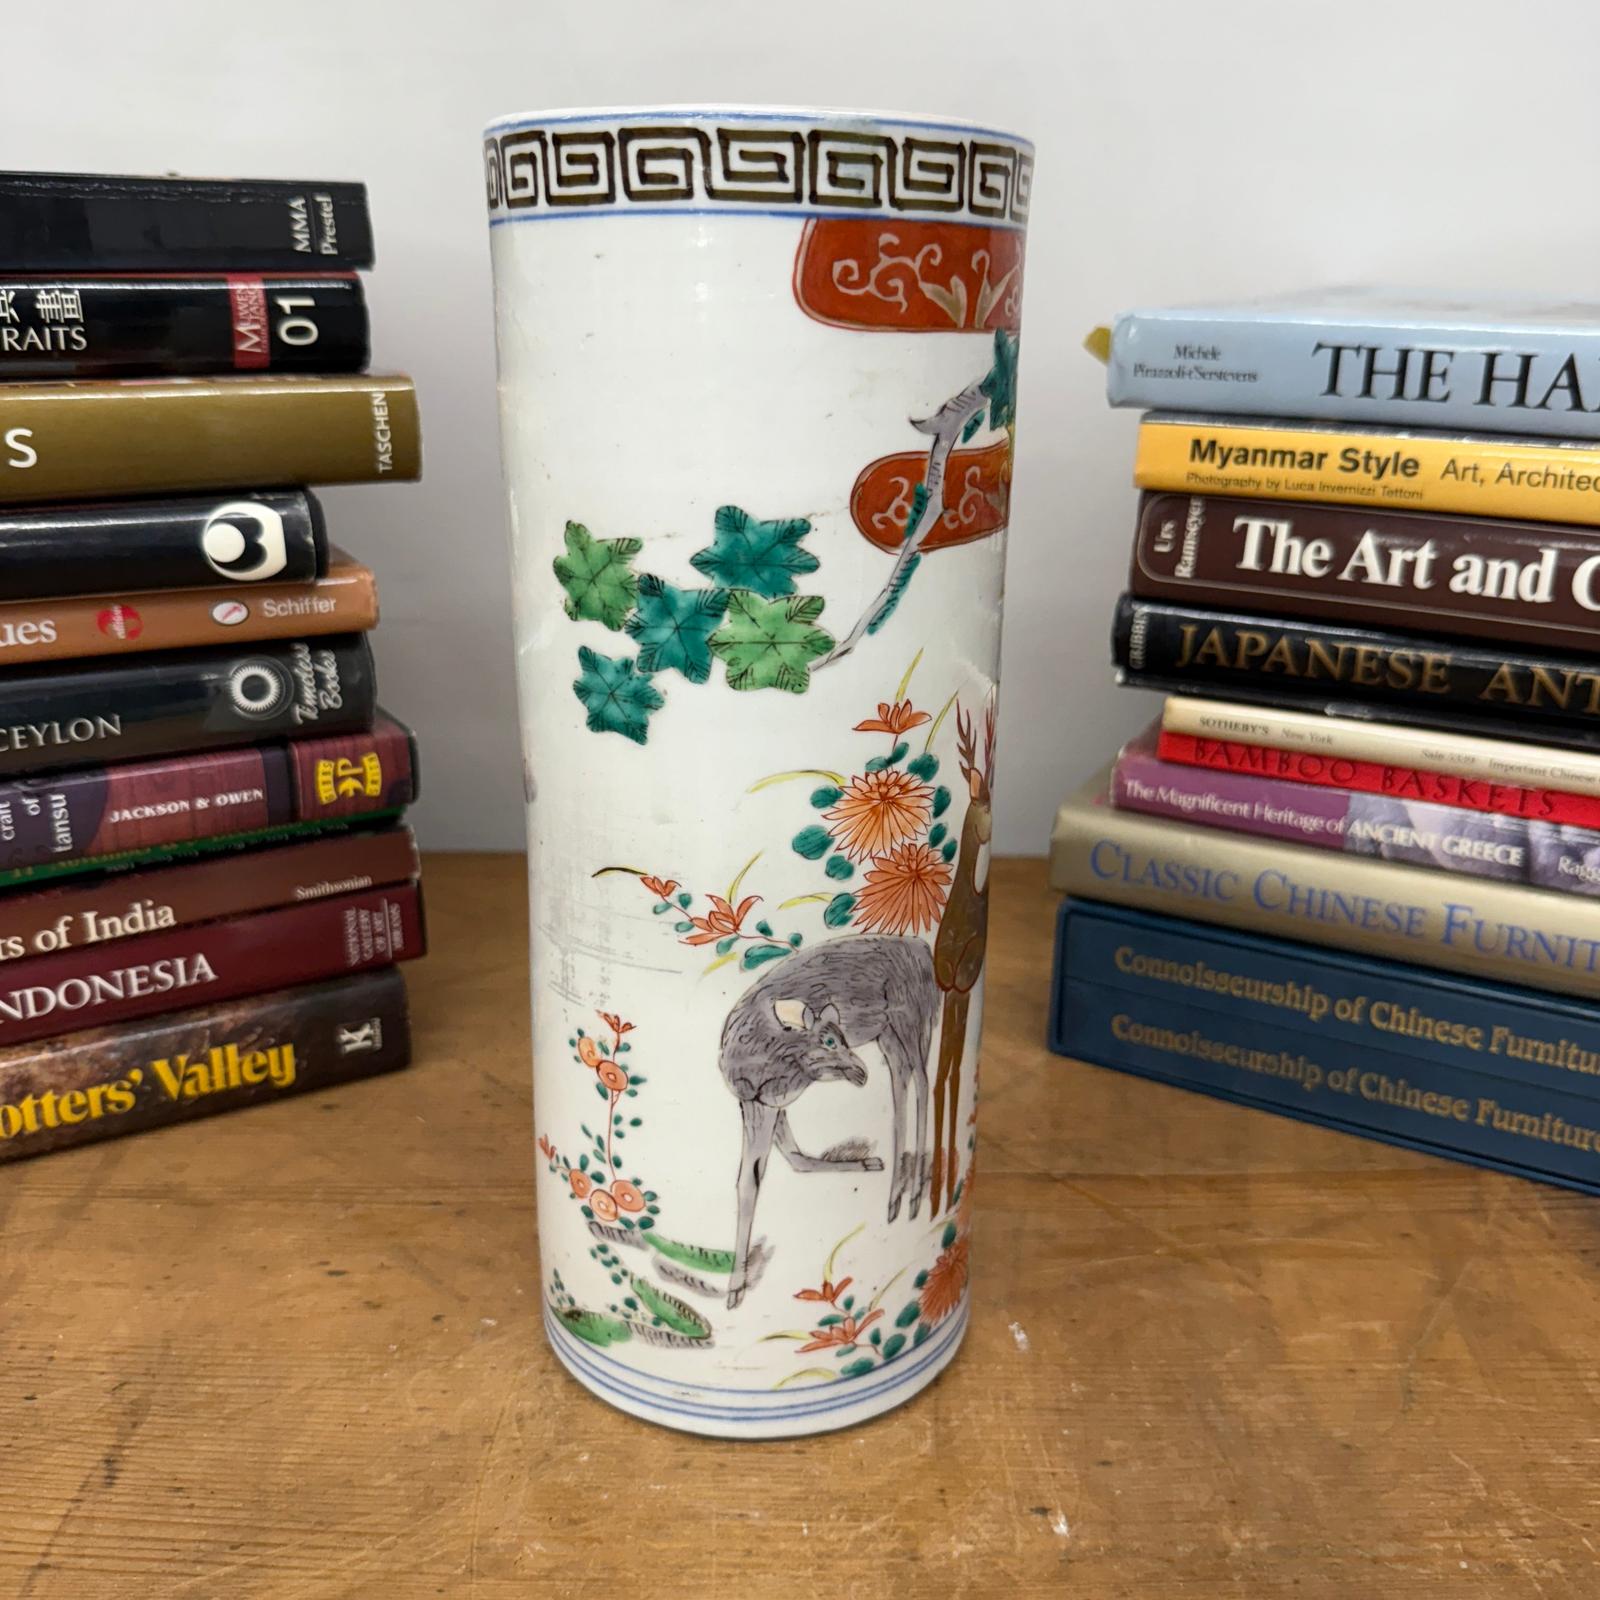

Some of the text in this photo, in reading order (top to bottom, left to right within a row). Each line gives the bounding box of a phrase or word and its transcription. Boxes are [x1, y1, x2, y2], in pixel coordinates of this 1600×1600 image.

[288, 196, 311, 253] MMA
[314, 194, 338, 255] Prestel
[2, 326, 87, 351] RAITS
[276, 296, 319, 346] 01
[1312, 340, 1600, 413] THE HA
[5, 427, 38, 469] S
[372, 392, 392, 474] TASCHEN
[1189, 438, 1328, 470] Myanmar
[1338, 446, 1421, 481] Style
[1440, 457, 1485, 488] Art,
[1186, 471, 1262, 490] Photography
[1266, 477, 1280, 492] by
[1284, 479, 1315, 492] Luca
[1153, 518, 1177, 553] Urs
[1232, 513, 1335, 580] The
[1338, 529, 1440, 591] Art
[1448, 547, 1559, 603] and
[262, 596, 337, 619] Schiffer
[291, 642, 319, 725] Timeless
[314, 650, 342, 710] Books
[1175, 622, 1600, 715] JAPANESE ANT
[1194, 737, 1556, 817] BAMBOO BASKETS
[1199, 716, 1270, 736] SOTHEBY'S
[1281, 727, 1304, 741] New
[1309, 731, 1334, 745] York
[1488, 758, 1547, 778] Important
[1550, 767, 1596, 784] Chinese
[50, 792, 74, 853] tansu
[109, 787, 264, 824] JACKSON & OWEN
[1126, 779, 1155, 800] The
[1156, 786, 1250, 817] Magnificent
[1253, 802, 1325, 835] Heritage
[1326, 815, 1345, 836] of
[1346, 819, 1440, 852] ANCIENT
[1441, 835, 1524, 868] GREECE
[296, 873, 373, 899] Smithsonian
[1089, 838, 1240, 902] CLASSIC
[1252, 868, 1427, 939] CHINESE
[33, 915, 74, 951] of
[81, 899, 177, 943] India
[0, 952, 218, 1025] NDONESIA
[1114, 945, 1329, 1024] Connoisseurship
[1334, 996, 1365, 1024] of
[1369, 1000, 1484, 1053] Chinese
[151, 1041, 297, 1103] Valley
[1110, 1013, 1323, 1090] Connoisseurship
[1327, 1065, 1357, 1094] of
[1358, 1069, 1471, 1122] Chinese
